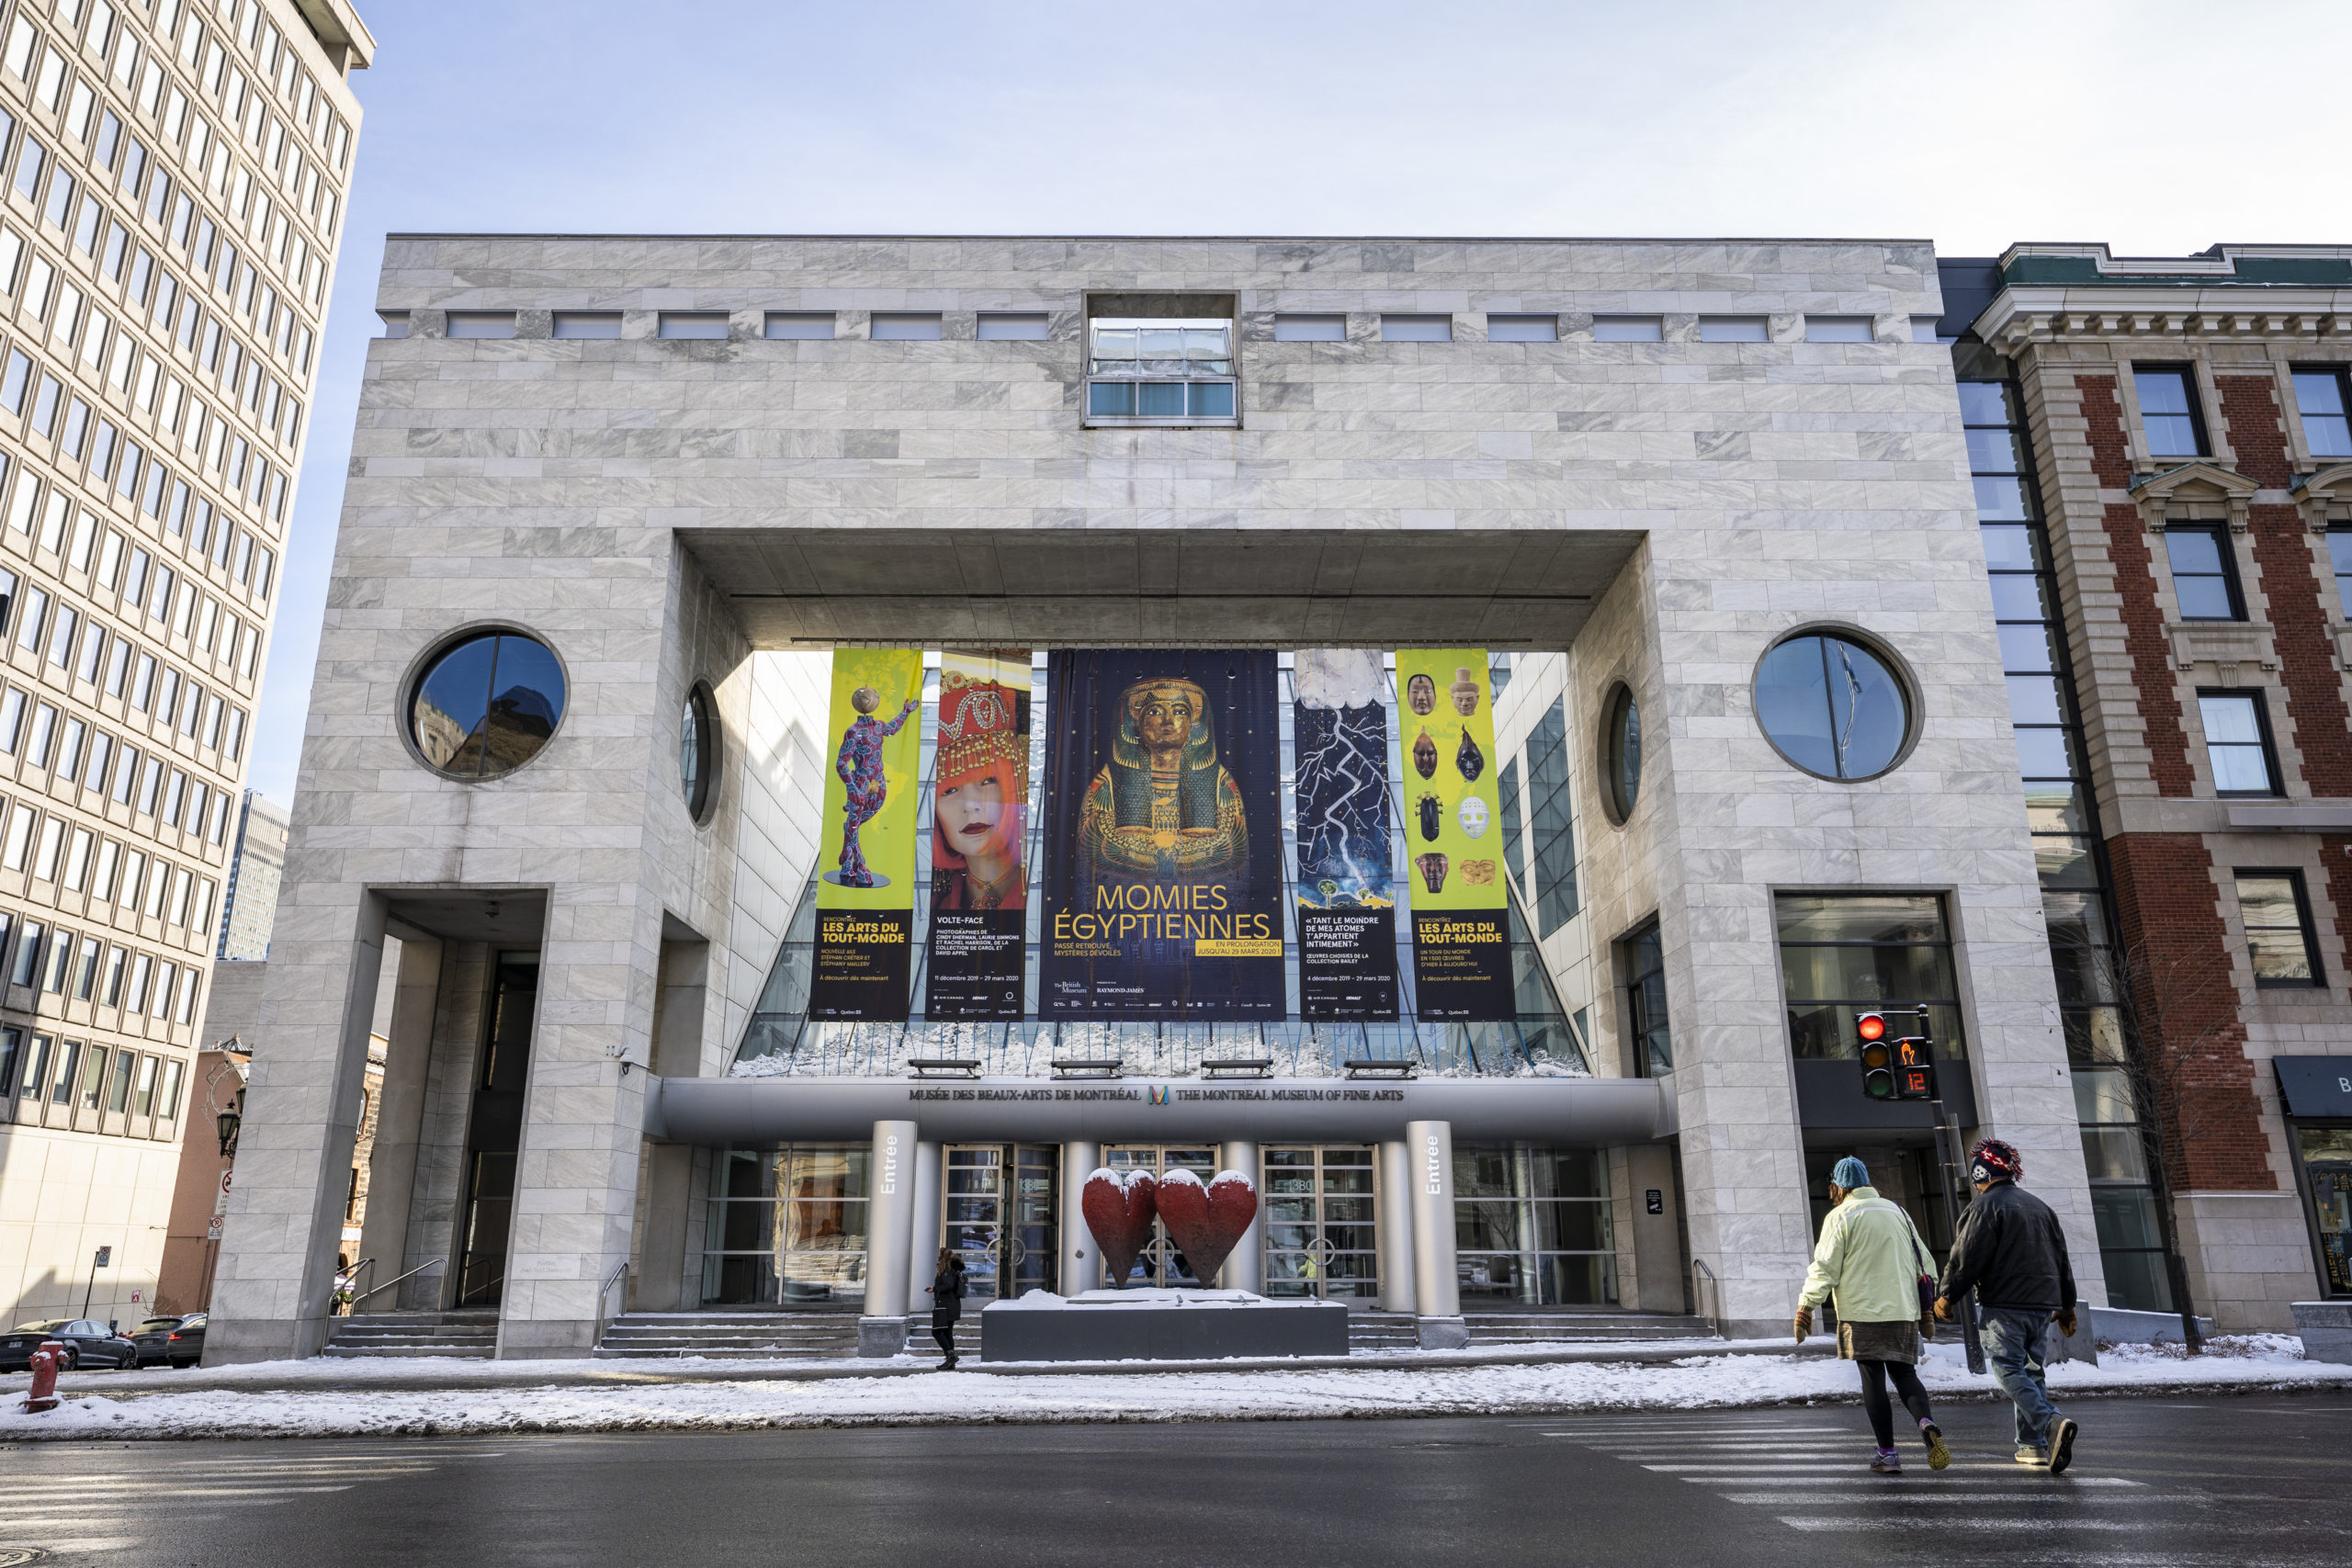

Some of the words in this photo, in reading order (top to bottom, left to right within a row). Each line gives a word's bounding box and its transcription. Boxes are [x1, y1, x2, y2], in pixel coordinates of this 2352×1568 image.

[1097, 885, 1227, 910] MOMIES
[823, 923, 844, 932] LES
[846, 923, 879, 932] ARTS
[882, 923, 899, 932] DU
[1054, 908, 1271, 939] ÉGYPTIENNES
[1419, 923, 1440, 933] LES
[1443, 923, 1475, 933] ARTS
[1478, 922, 1495, 932] DU
[822, 933, 905, 943] TOUT-MONDE
[1419, 933, 1503, 943] TOUT-MONDE
[1908, 1073, 1925, 1090] 12
[909, 1088, 950, 1100] MUSÉE
[953, 1090, 975, 1100] DES
[977, 1090, 1052, 1100] BEAUX-ARTS
[1056, 1090, 1070, 1100] DE
[1074, 1088, 1140, 1100] MONTRÉAL
[1176, 1090, 1200, 1100] THE
[1202, 1090, 1270, 1100] MONTREAL
[1271, 1090, 1324, 1100] MUSEUM
[1326, 1090, 1341, 1100] OF
[1343, 1090, 1370, 1100] FINE
[1373, 1090, 1403, 1100] ARTS
[881, 1135, 897, 1194] Entrée
[1426, 1135, 1441, 1195] Entrée
[1019, 1180, 1038, 1191] 1380
[1288, 1180, 1313, 1191] 1380
